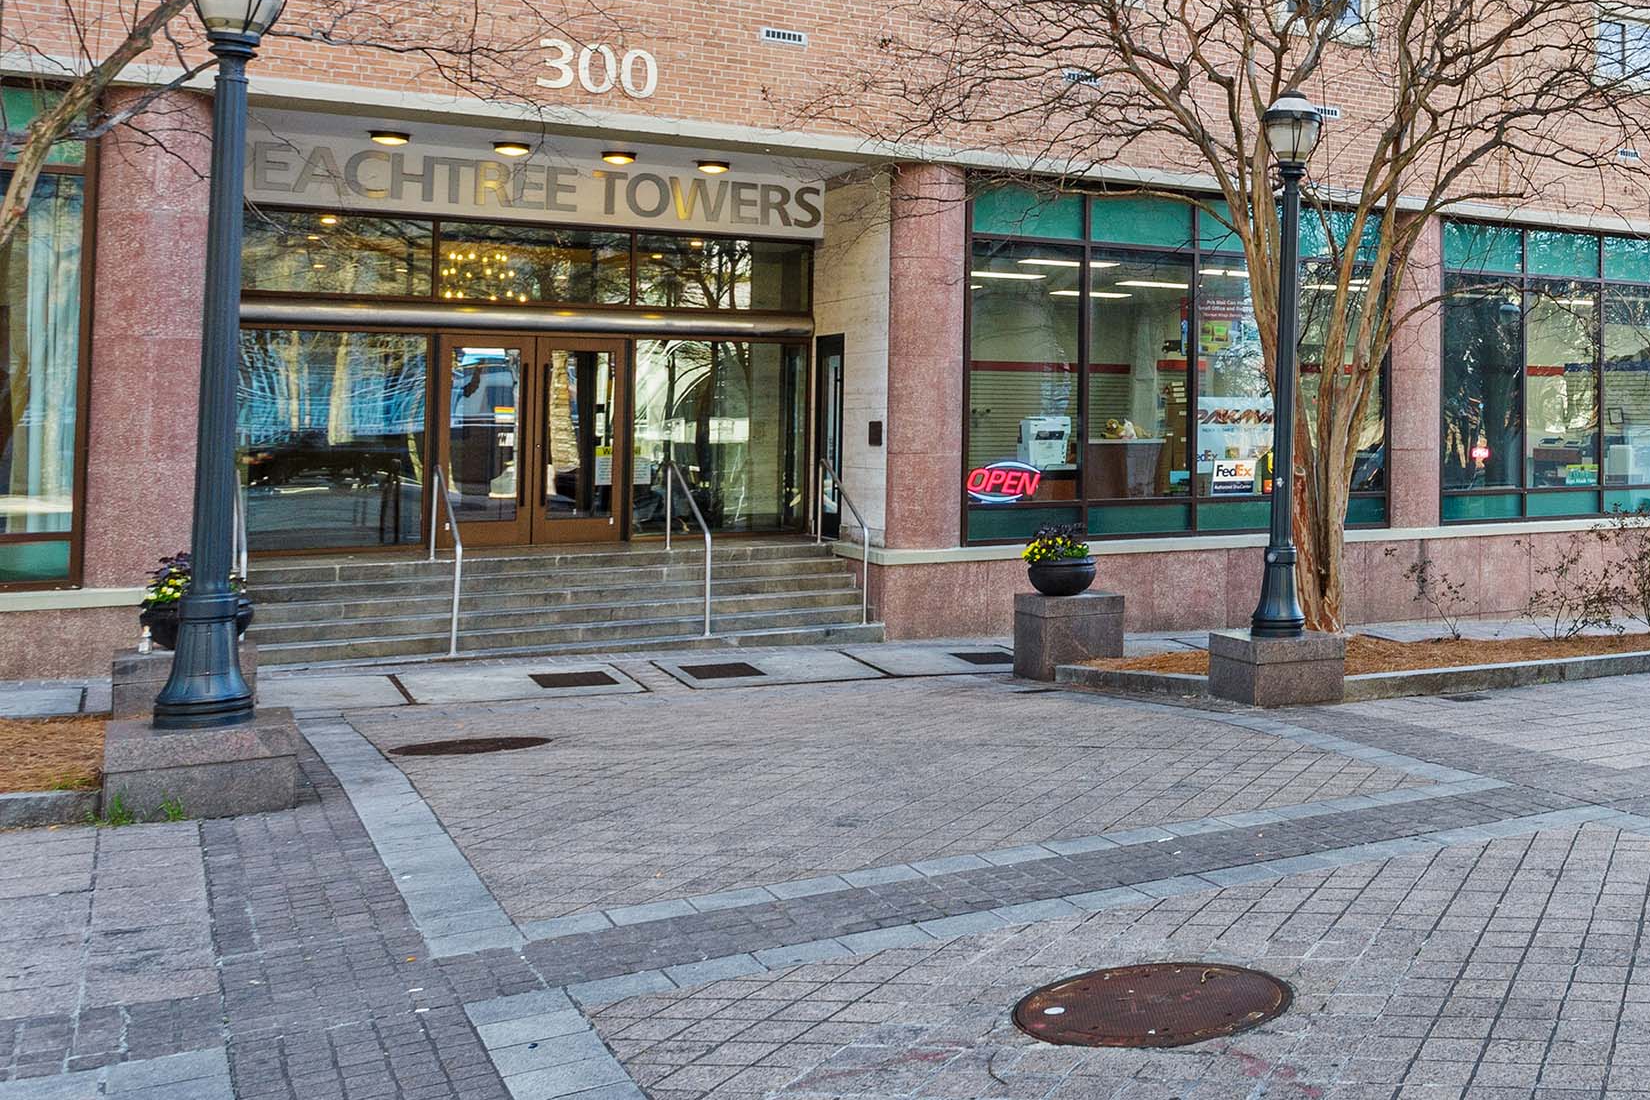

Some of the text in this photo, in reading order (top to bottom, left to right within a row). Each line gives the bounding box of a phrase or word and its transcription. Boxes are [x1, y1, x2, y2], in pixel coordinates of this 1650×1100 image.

[535, 37, 658, 100] 300
[244, 140, 822, 230] EACHTREE TOWERS
[966, 467, 1041, 497] OPEN
[1215, 464, 1253, 478] FedEx
